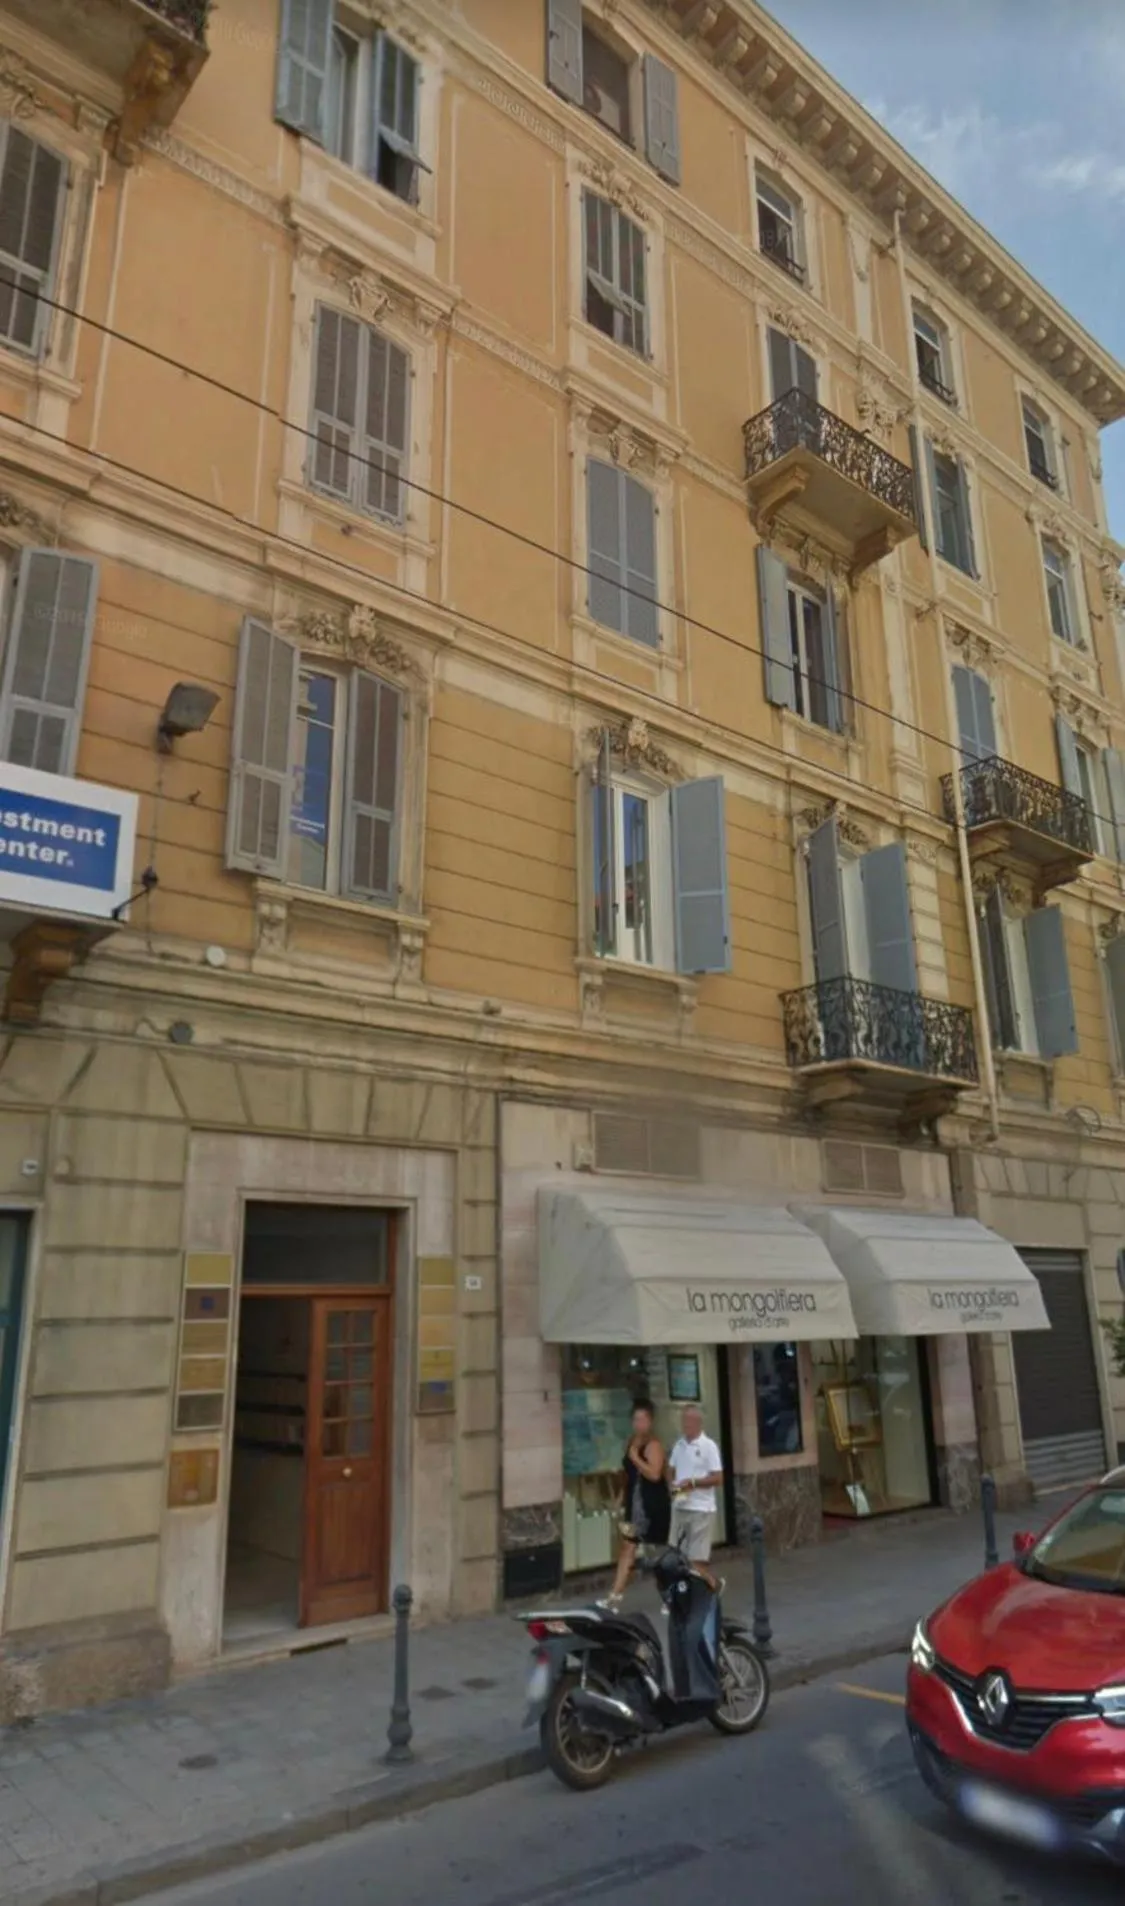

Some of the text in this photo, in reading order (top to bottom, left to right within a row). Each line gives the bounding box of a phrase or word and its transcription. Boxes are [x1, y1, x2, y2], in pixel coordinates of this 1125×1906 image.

[0, 810, 107, 847] stment
[685, 1287, 817, 1318] la mongolfiera
